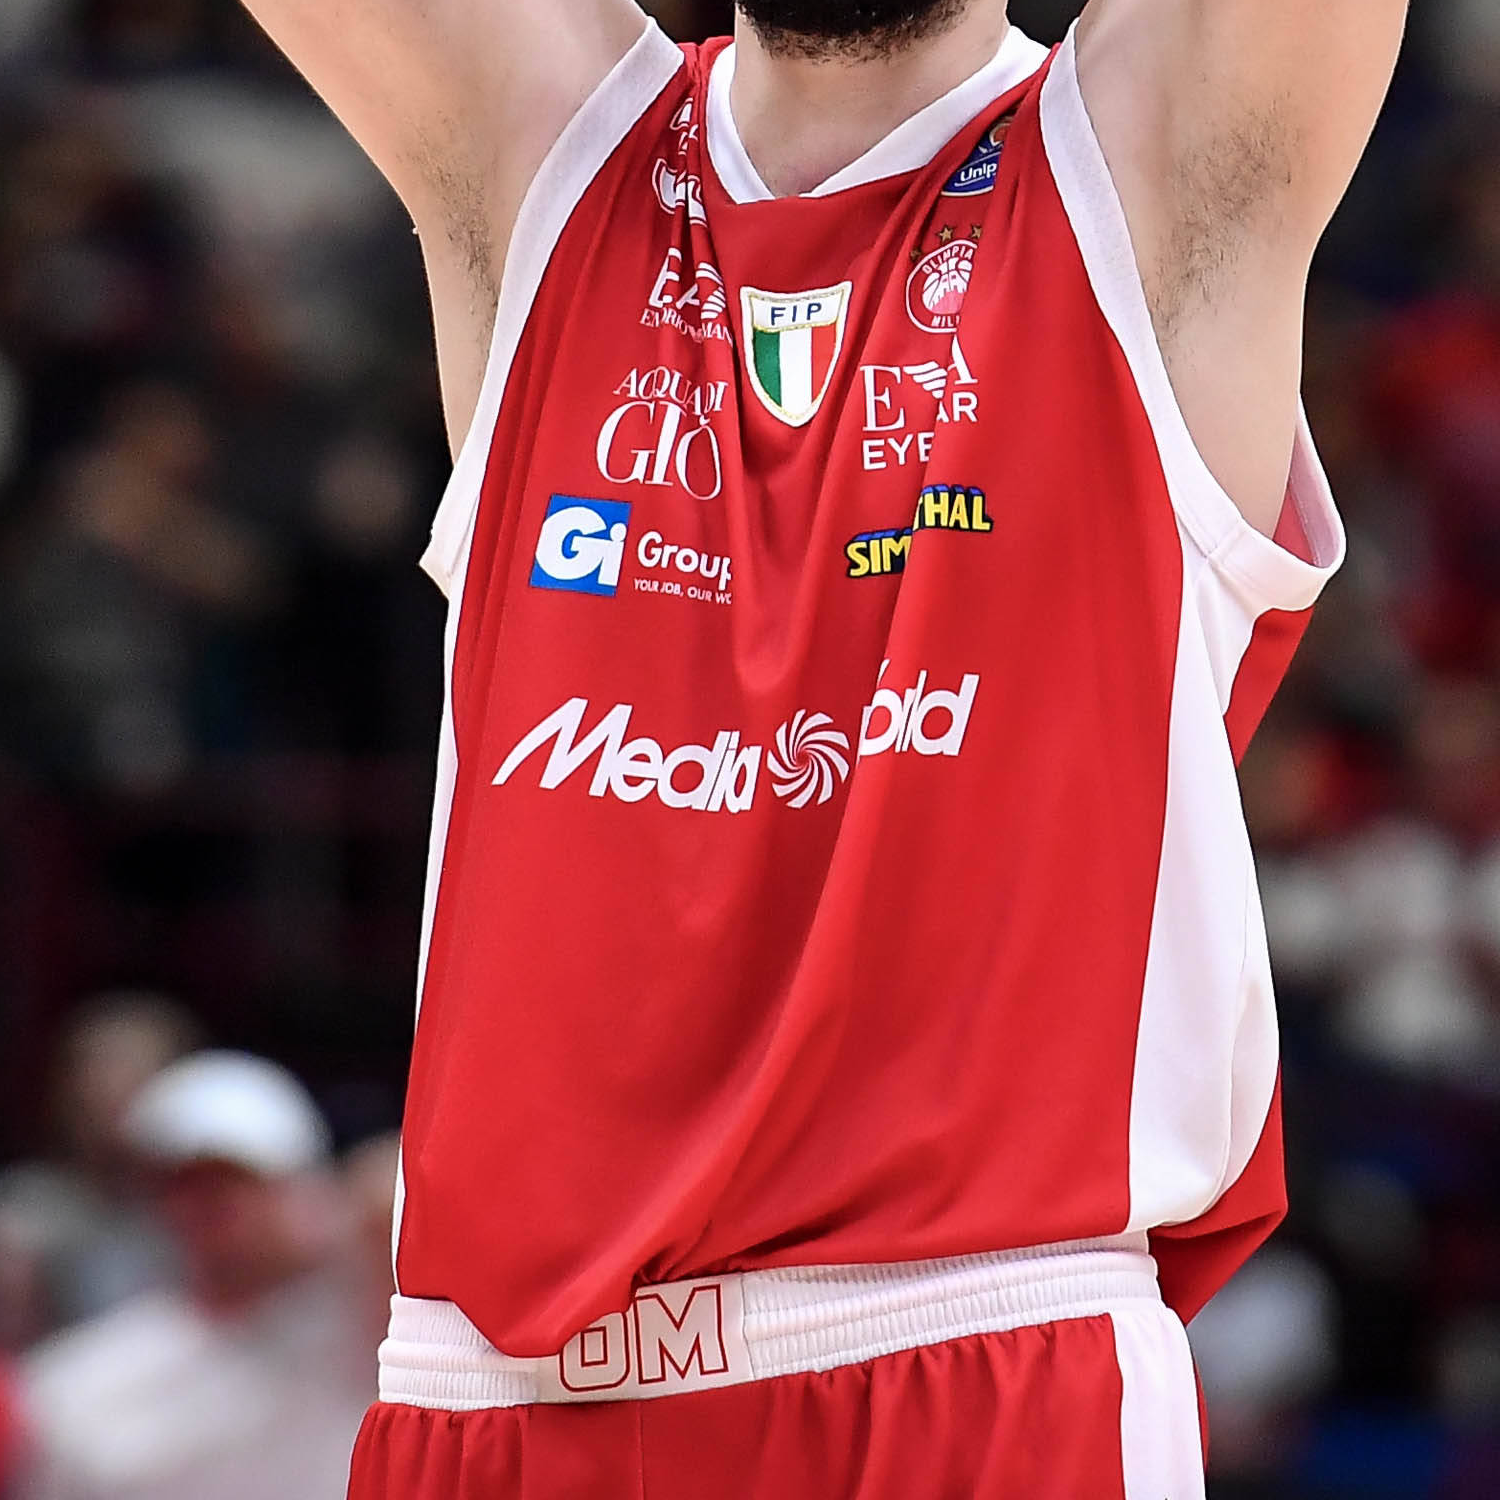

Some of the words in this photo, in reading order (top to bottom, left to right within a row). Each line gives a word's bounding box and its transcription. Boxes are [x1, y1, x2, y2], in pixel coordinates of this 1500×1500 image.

[961, 163, 998, 182] Unip
[921, 245, 974, 275] OLIMPIA
[770, 302, 822, 326] FIP
[612, 366, 703, 417] ACQUA
[862, 391, 979, 471] EYEAR
[535, 506, 627, 587] Gi
[846, 490, 992, 578] SIMHAL
[634, 578, 659, 593] YOUR
[660, 581, 684, 597] JOB,
[687, 586, 712, 602] OUR
[491, 696, 763, 814] Media
[857, 658, 980, 766] orld
